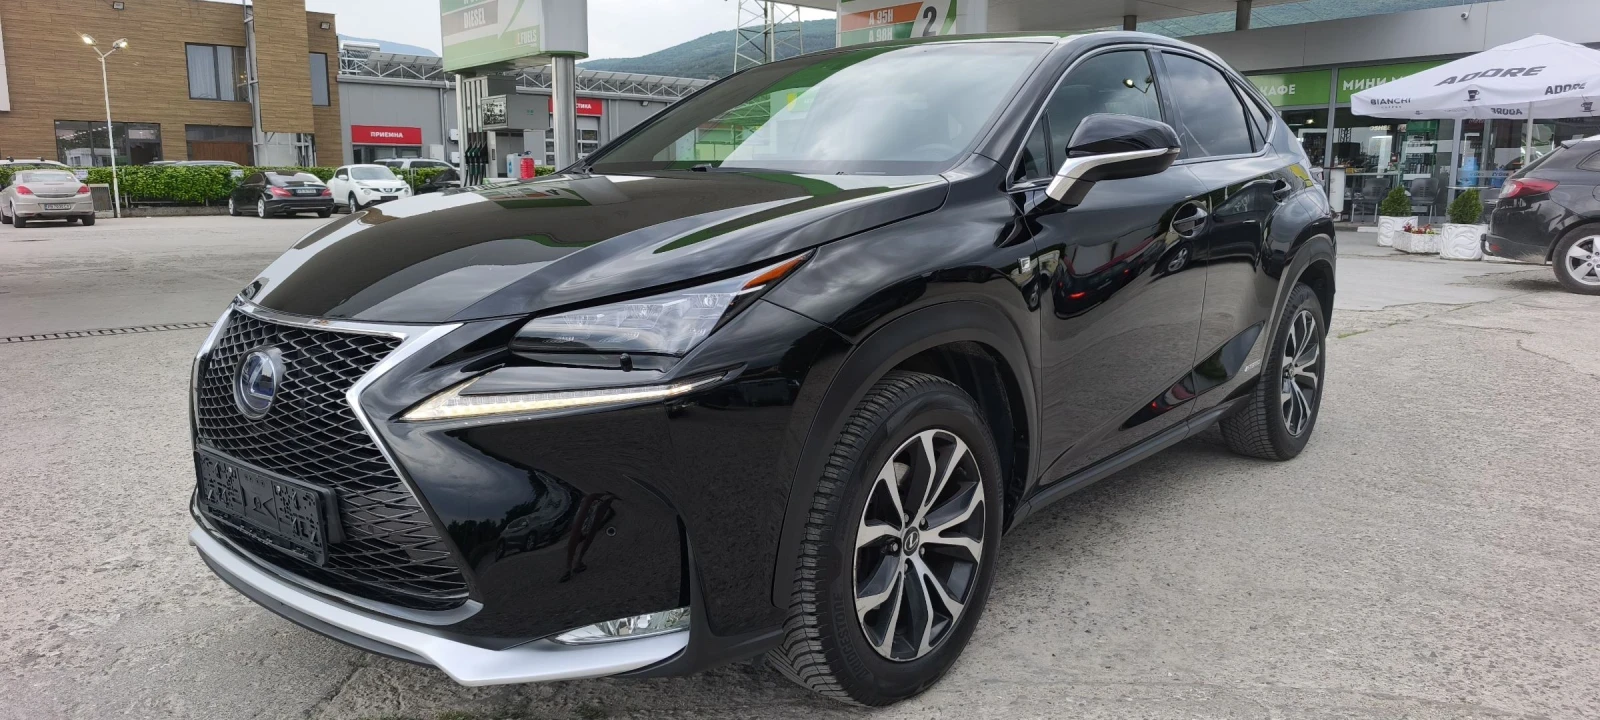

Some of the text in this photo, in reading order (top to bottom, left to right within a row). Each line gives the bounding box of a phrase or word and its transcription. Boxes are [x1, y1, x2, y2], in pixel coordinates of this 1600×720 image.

[464, 8, 486, 28] DIESEL
[923, 6, 937, 37] 2
[1342, 77, 1387, 91] МИНИ
[1434, 66, 1547, 87] ADORE
